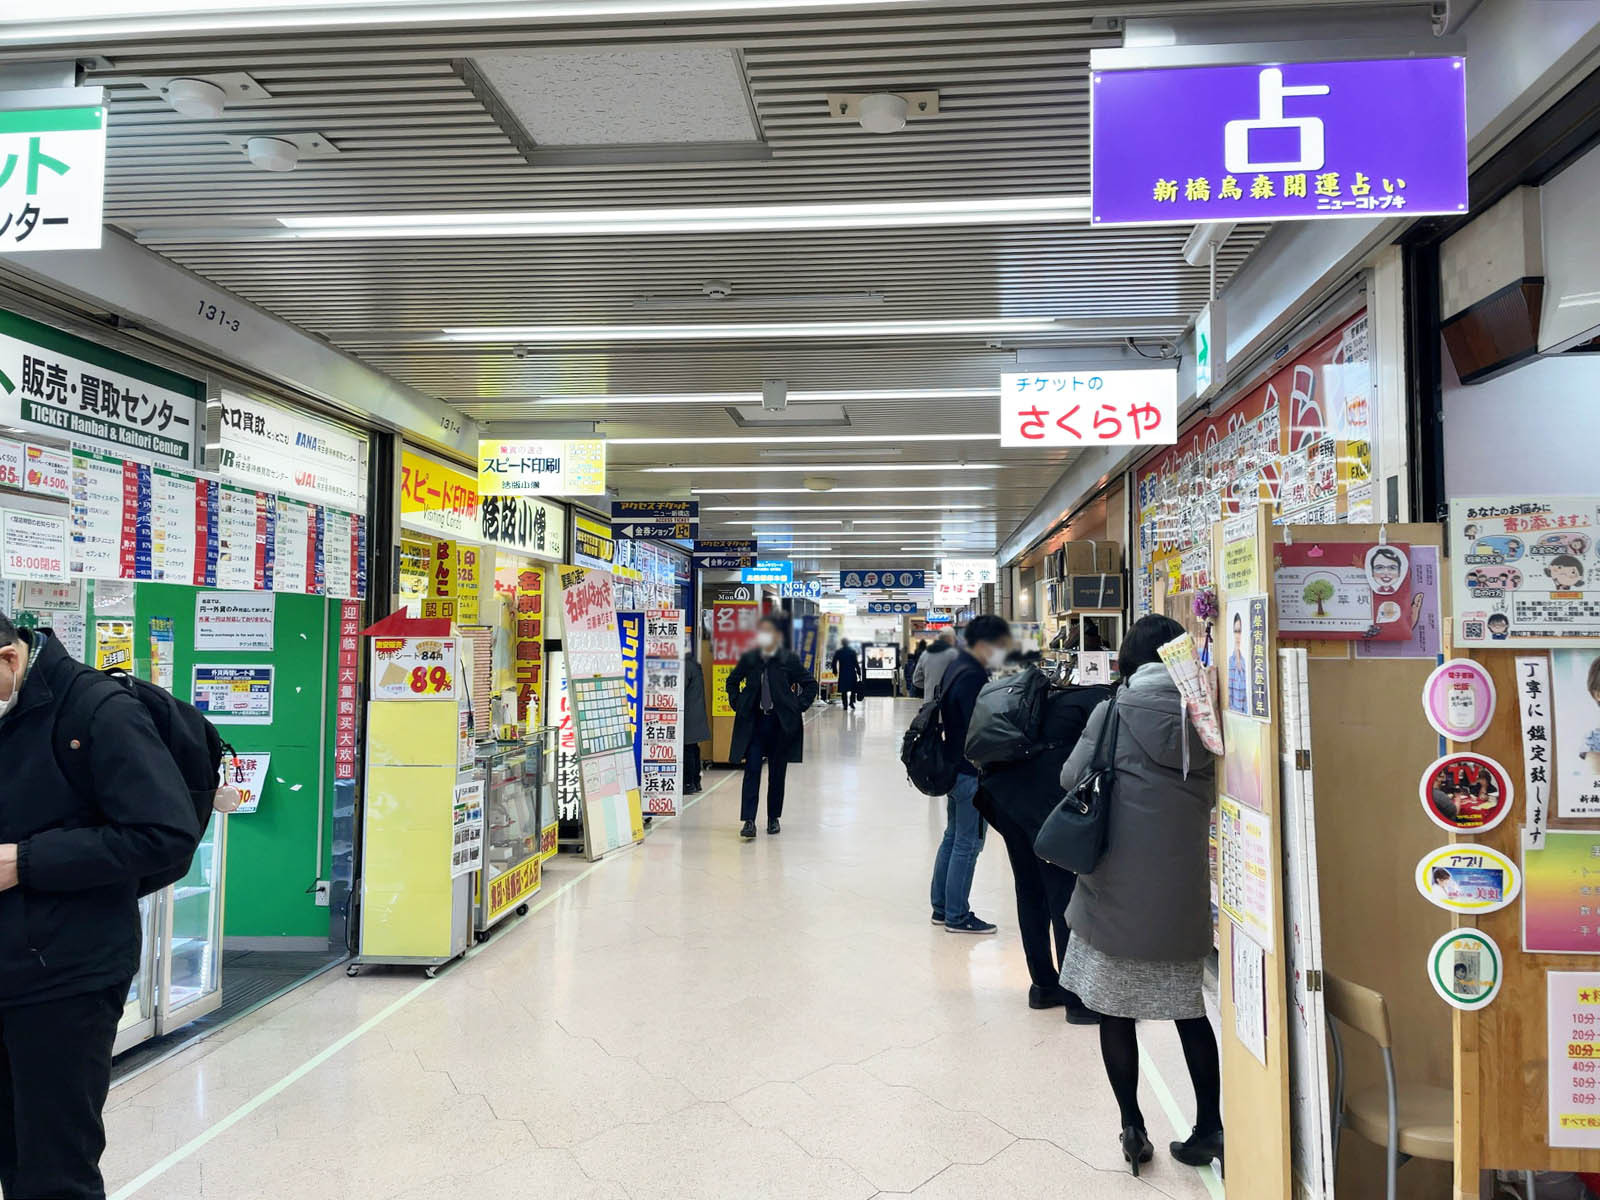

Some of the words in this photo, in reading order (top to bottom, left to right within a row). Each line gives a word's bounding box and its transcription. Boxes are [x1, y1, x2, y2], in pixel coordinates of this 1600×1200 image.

[1224, 67, 1330, 173] 占
[1316, 196, 1406, 211] ニューコトブキ
[197, 300, 241, 332] 131-3
[1016, 376, 1104, 392] チケットの
[21, 354, 190, 431] 販売・買取センター
[1017, 401, 1162, 440] さくらや
[29, 403, 69, 427] TICKET
[70, 414, 108, 438] Hanbai
[109, 426, 117, 440] &
[118, 427, 151, 449] Kaitori
[152, 437, 183, 457] Center
[482, 457, 560, 474] スピード印刷
[402, 466, 478, 521] スピード印刷
[621, 502, 690, 510] アクセスチケット
[1467, 503, 1551, 519] あなたのお悩みに
[635, 526, 676, 537] 金券ショップ
[10, 555, 61, 571] 18:00閉店
[435, 542, 450, 597] はんこ
[425, 602, 454, 617] 認印
[648, 622, 678, 636] 新大阪
[647, 674, 678, 688] 京都
[645, 694, 675, 707] 11950
[646, 726, 676, 740] 名古屋
[649, 745, 674, 759] 9700
[1522, 662, 1547, 845] 丁寧に鑑定致します
[1448, 766, 1480, 785] TV
[644, 777, 675, 792] 浜松
[648, 798, 673, 812] 6850
[1450, 856, 1483, 868] アプリ
